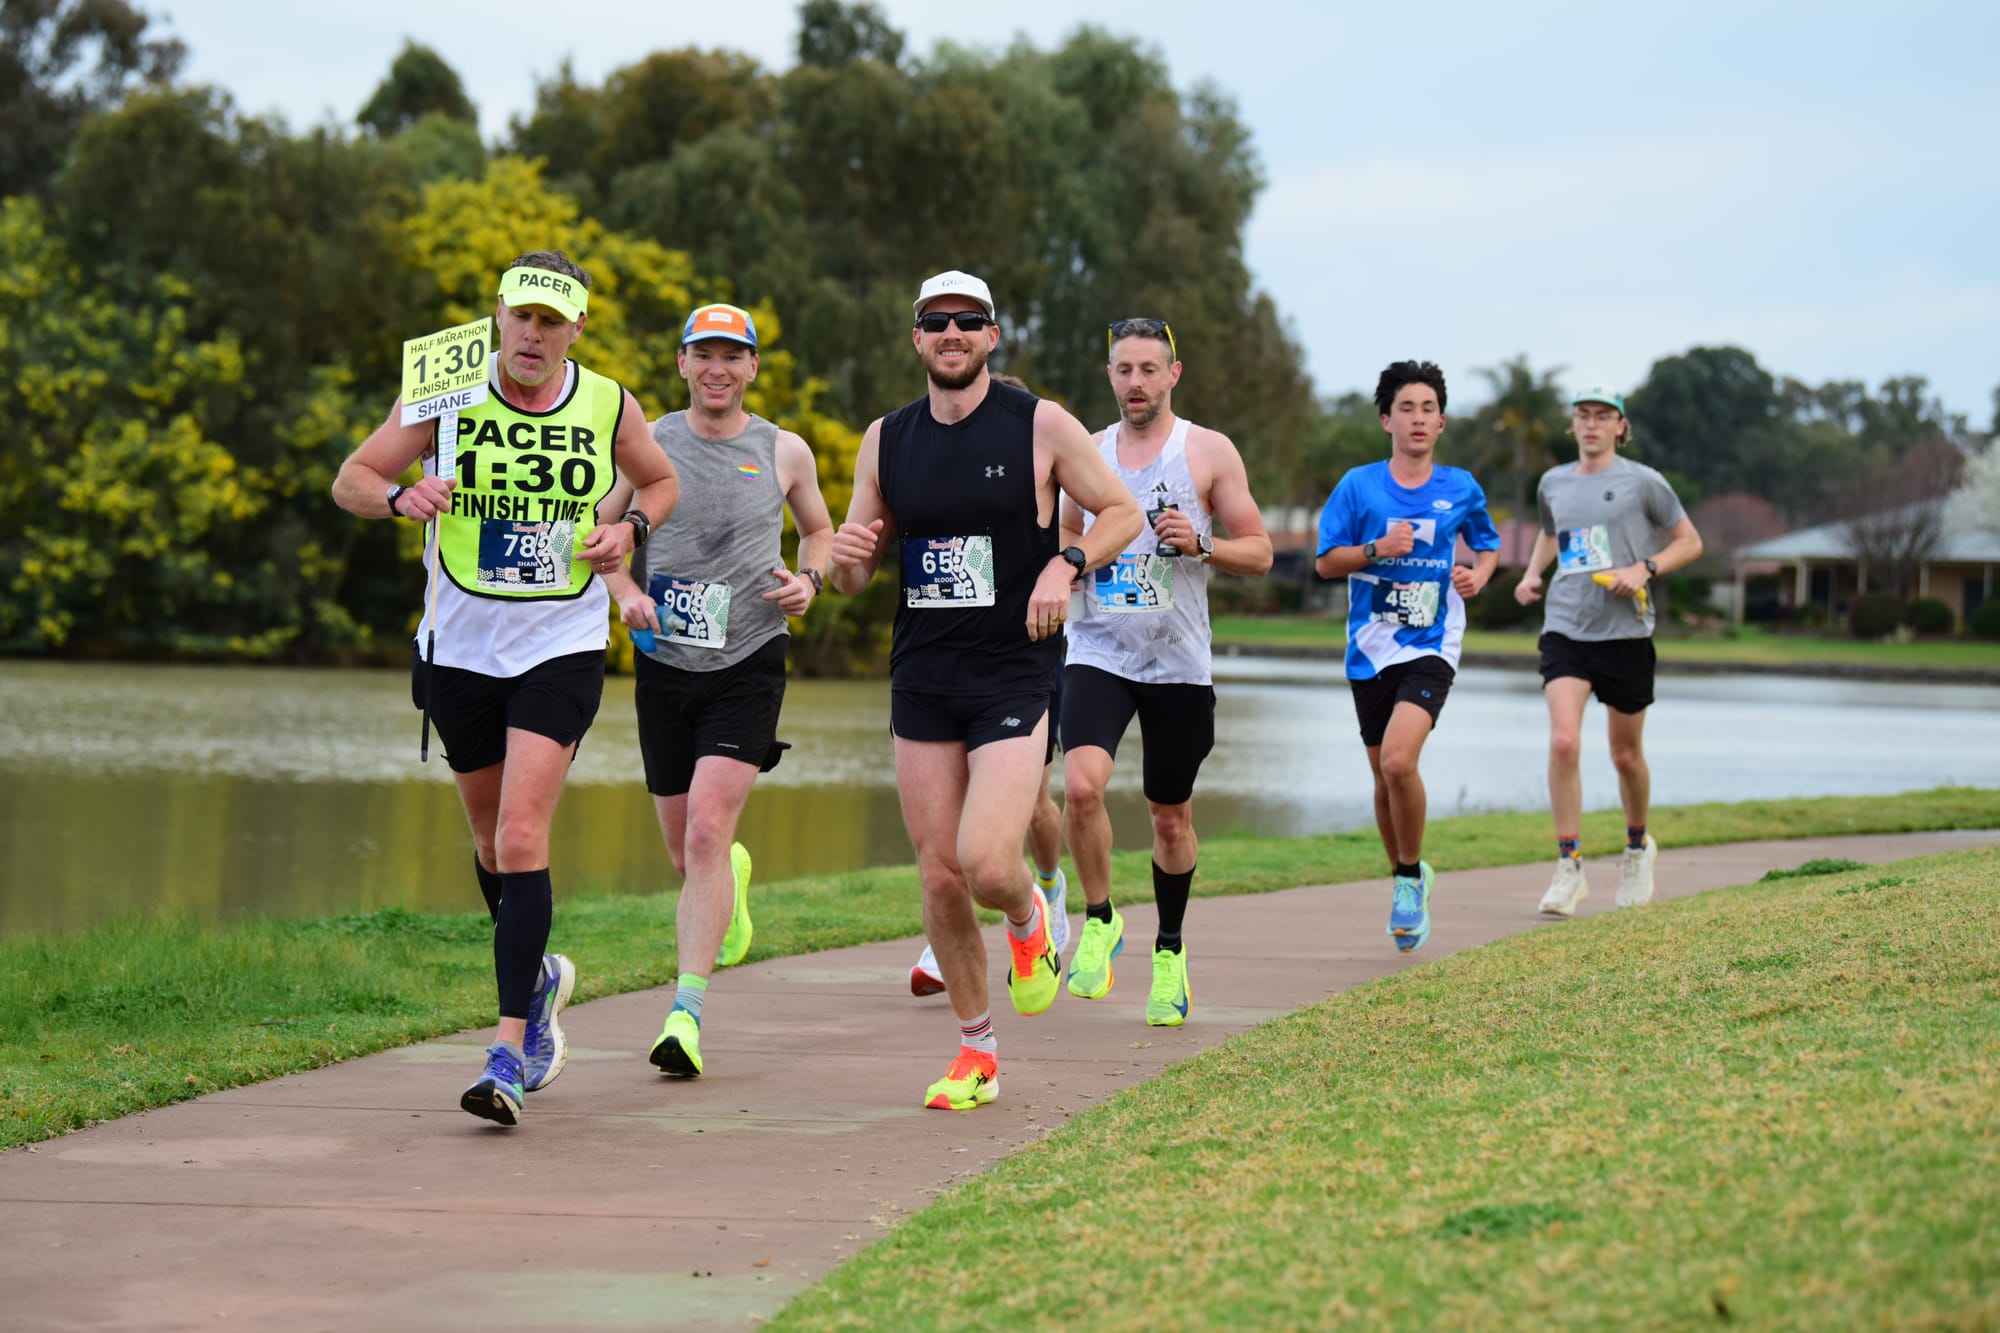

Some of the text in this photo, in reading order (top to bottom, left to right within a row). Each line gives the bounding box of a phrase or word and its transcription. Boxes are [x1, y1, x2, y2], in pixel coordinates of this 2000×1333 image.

[519, 273, 571, 298] PACER
[410, 324, 488, 354] HALF MARATHON
[413, 339, 485, 384] 1:30
[412, 369, 483, 398] FINISH TIME
[418, 392, 472, 418] SHANE
[455, 417, 598, 456] PACER
[455, 450, 596, 497] 1:30
[451, 491, 590, 523] FINISH TIME
[503, 534, 553, 558] 782
[922, 551, 969, 574] 657
[664, 588, 708, 616] 909
